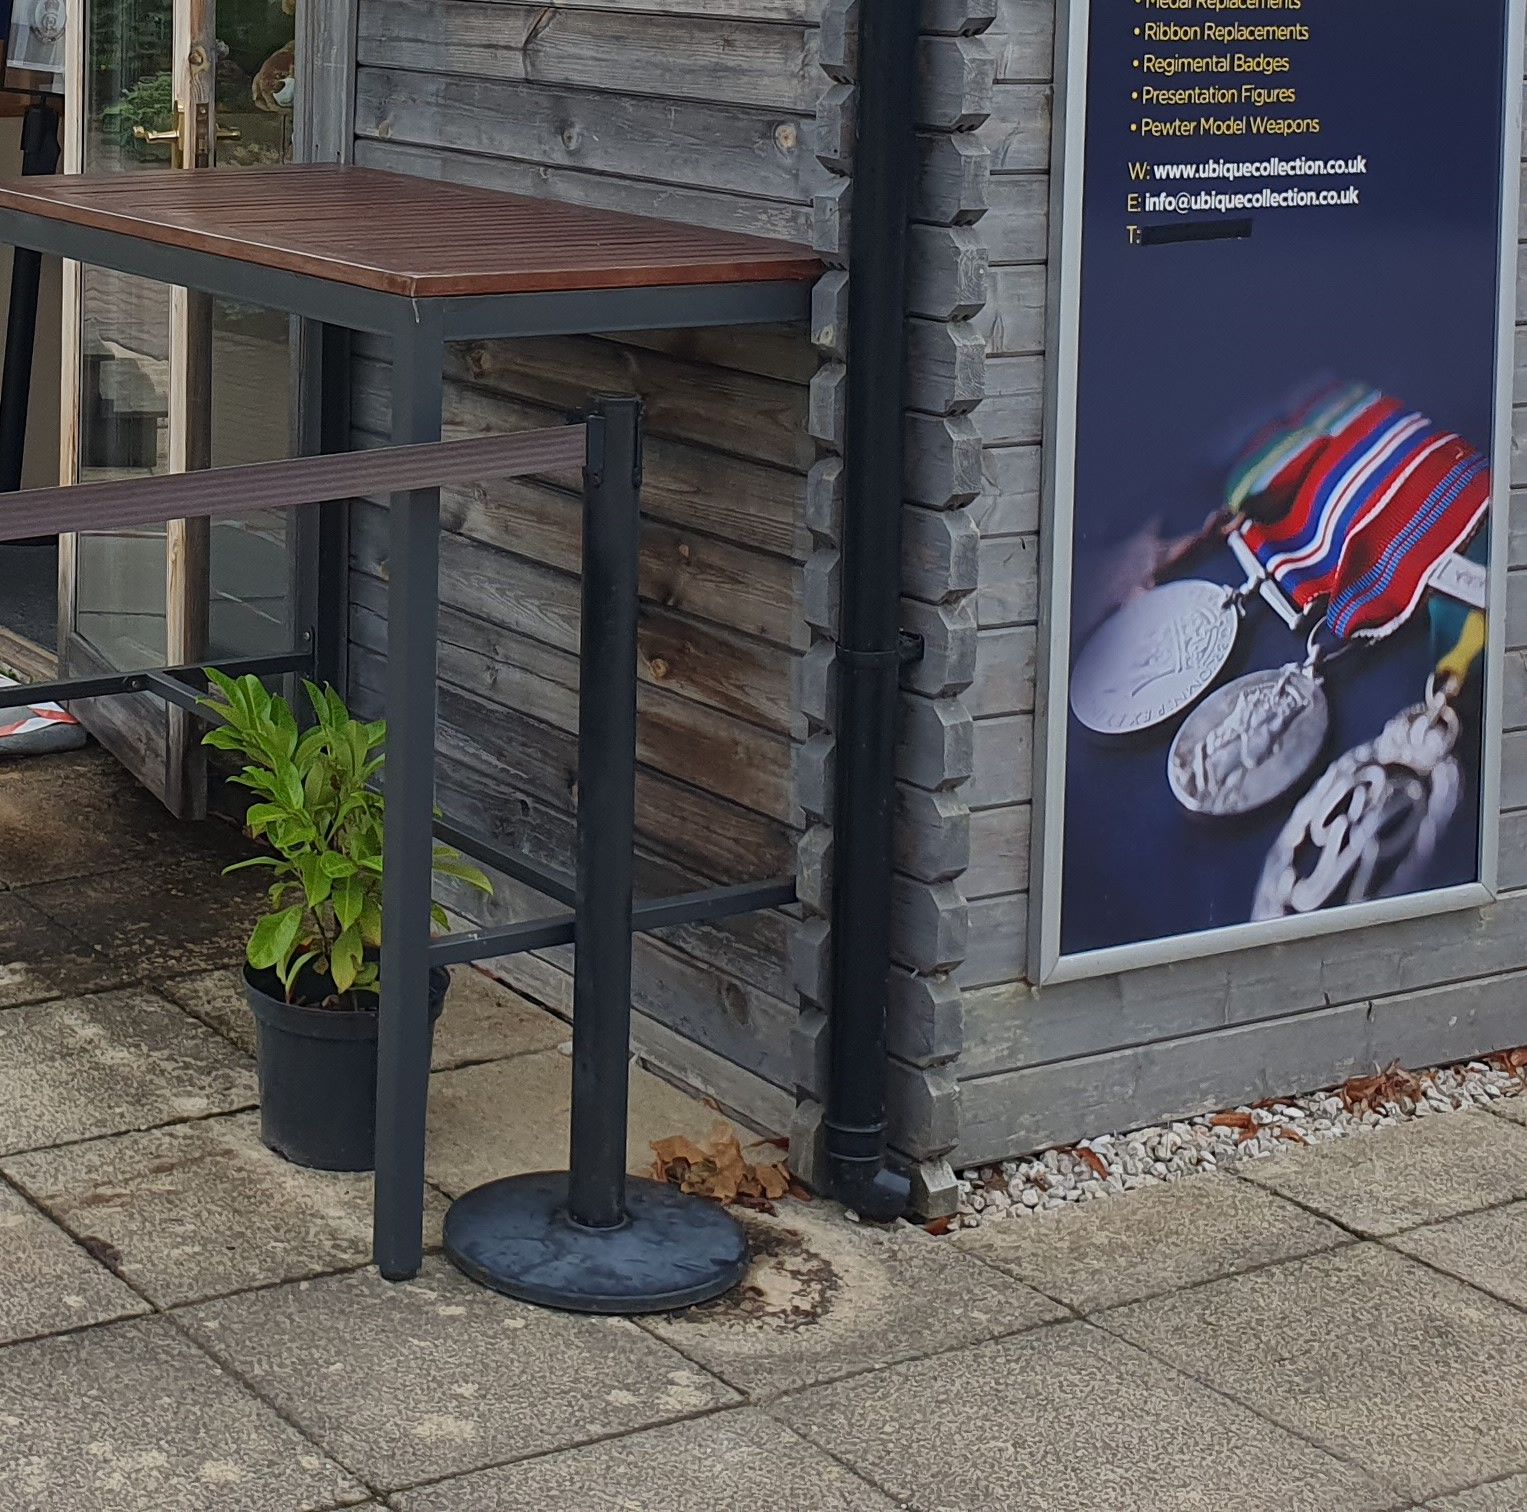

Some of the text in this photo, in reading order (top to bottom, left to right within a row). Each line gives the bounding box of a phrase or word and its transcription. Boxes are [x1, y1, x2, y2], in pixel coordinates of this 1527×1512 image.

[1144, 22, 1309, 43] Ribbon Replacements
[1143, 53, 1290, 76] Regimental Badges
[1142, 85, 1296, 106] Presentation Figures
[1141, 116, 1320, 136] Pewter Model Weapons
[1128, 155, 1367, 181] W: www.ubiquecollection.co.uk
[1127, 186, 1359, 214] E: info@ubiquecollection.co.uk
[1127, 226, 1141, 244] T:
